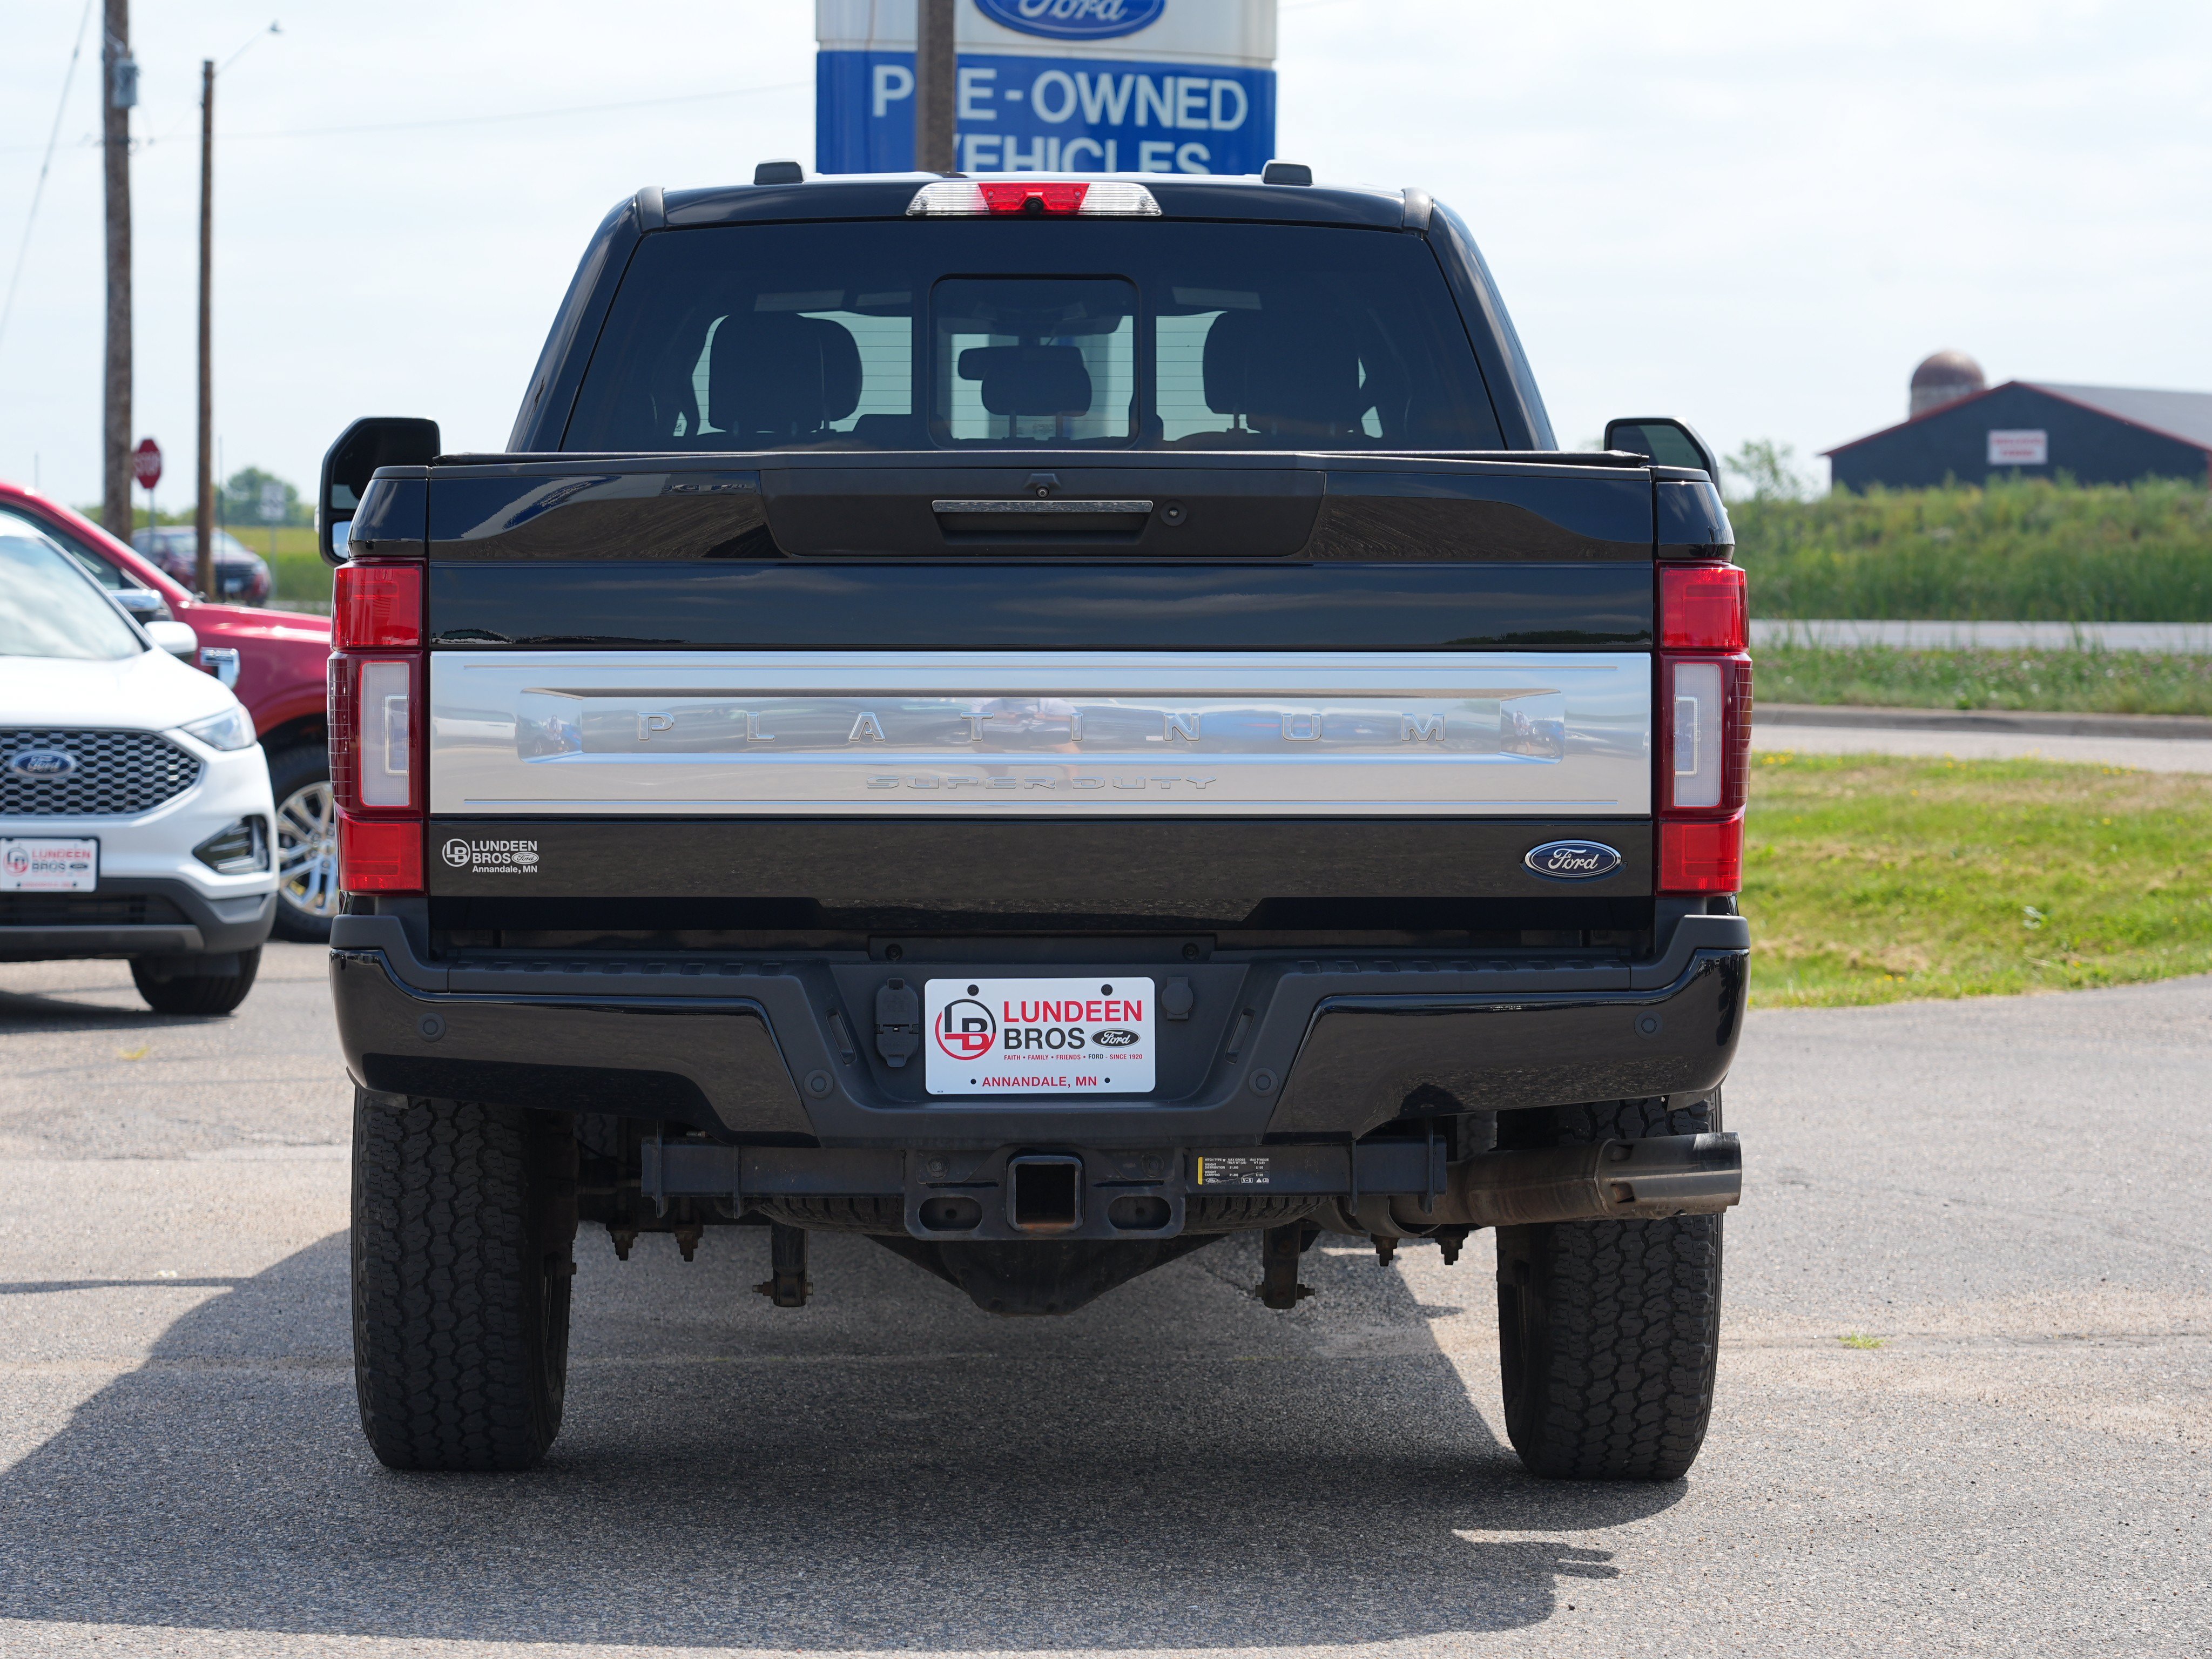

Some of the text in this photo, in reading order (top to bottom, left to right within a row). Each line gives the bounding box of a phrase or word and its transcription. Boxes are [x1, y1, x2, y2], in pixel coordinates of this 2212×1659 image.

[872, 64, 1249, 132] PE-OWNED
[953, 133, 1212, 174] EHICLES
[637, 712, 1445, 742] PLATINUM
[867, 776, 1216, 790] SUPER DUTY
[32, 848, 91, 859] LUNDEEN
[472, 840, 537, 851] LUNDEEN
[473, 853, 511, 864] BROS
[1548, 848, 1600, 869] Ford
[472, 865, 521, 874] Annandale,
[1003, 1000, 1142, 1022] LUNDEEN
[1004, 1027, 1085, 1049] BROS
[982, 1076, 1097, 1088] ANNANDALE, MN
